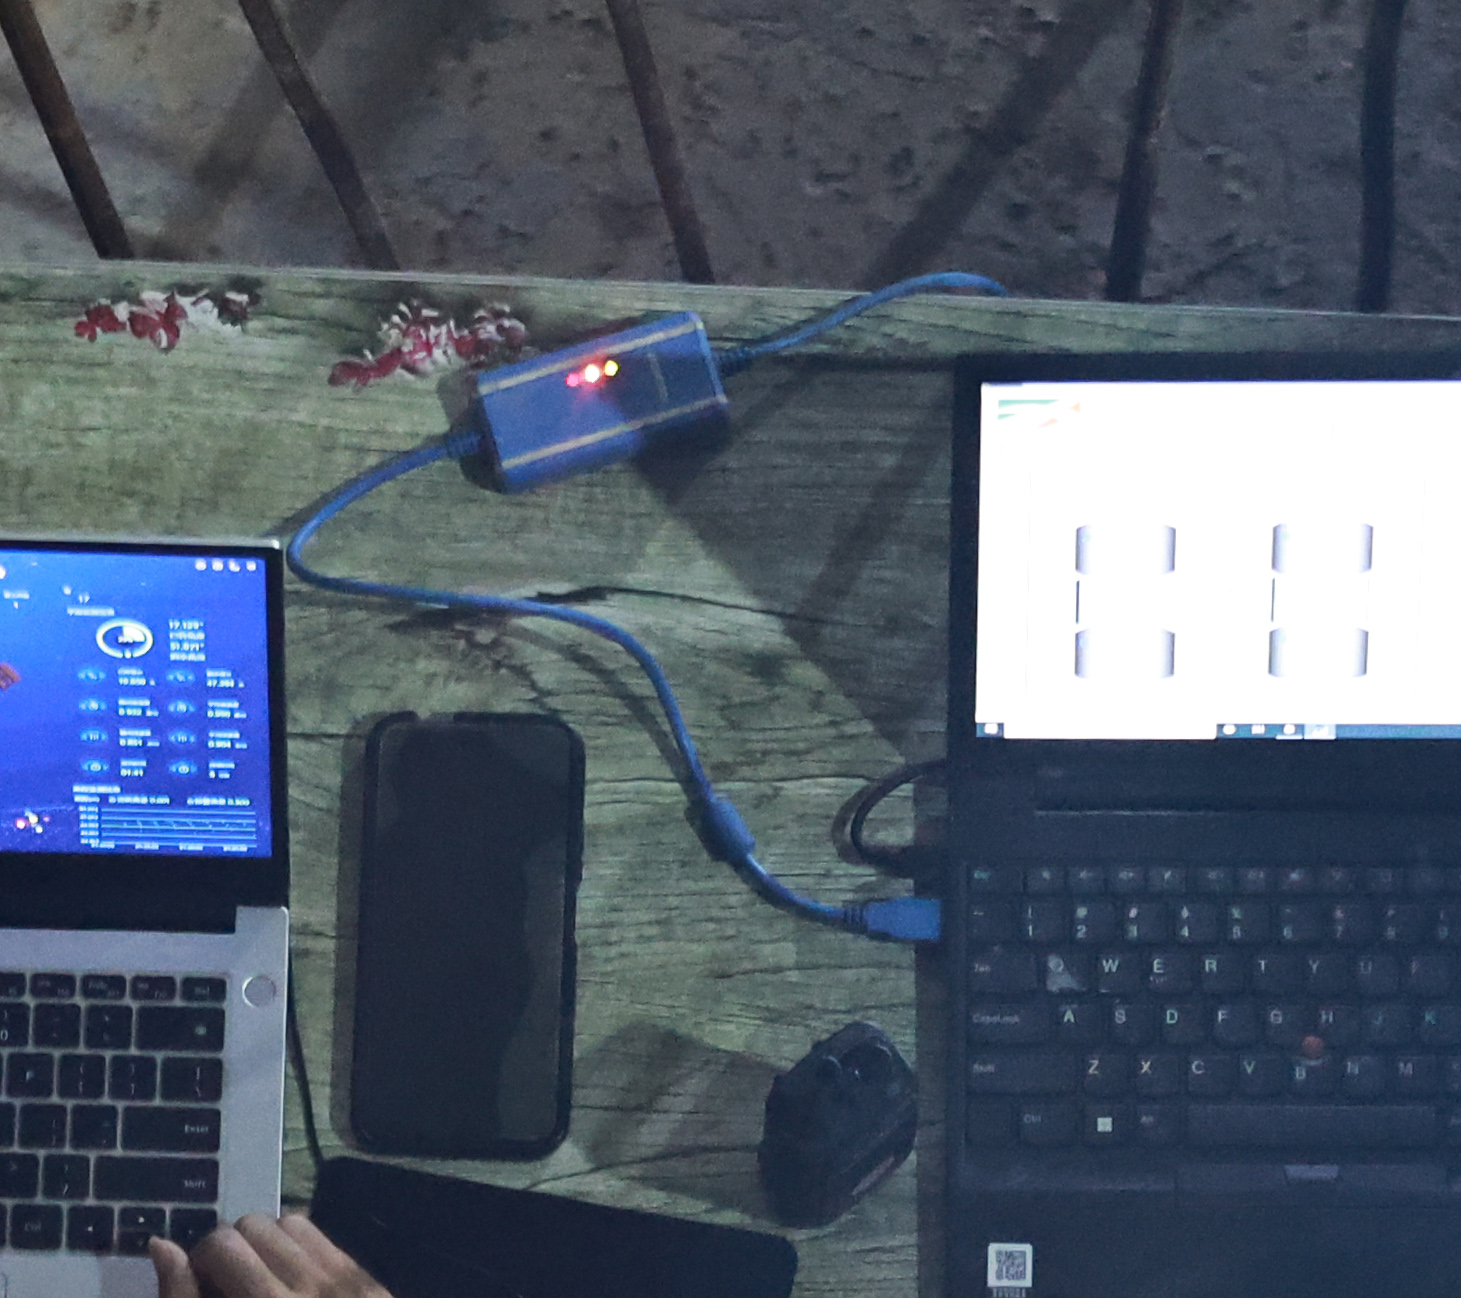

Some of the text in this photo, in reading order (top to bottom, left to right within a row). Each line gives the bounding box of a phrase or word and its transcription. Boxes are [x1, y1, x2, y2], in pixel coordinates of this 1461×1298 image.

[1077, 925, 1086, 938] 2
[1103, 959, 1118, 972] W
[1153, 959, 1165, 973] E
[1205, 959, 1216, 972] R
[1258, 959, 1268, 972] T
[1310, 960, 1319, 973] Y
[1064, 1009, 1074, 1022] A
[1115, 1009, 1126, 1023] S
[1166, 1009, 1178, 1024] D
[1322, 1011, 1333, 1023] H
[1425, 1012, 1435, 1024] K
[1089, 1060, 1098, 1074] Z
[1141, 1061, 1150, 1073] X
[1192, 1061, 1203, 1074] C
[1244, 1061, 1255, 1074] V
[1295, 1066, 1306, 1080] B
[1399, 1062, 1412, 1074] M
